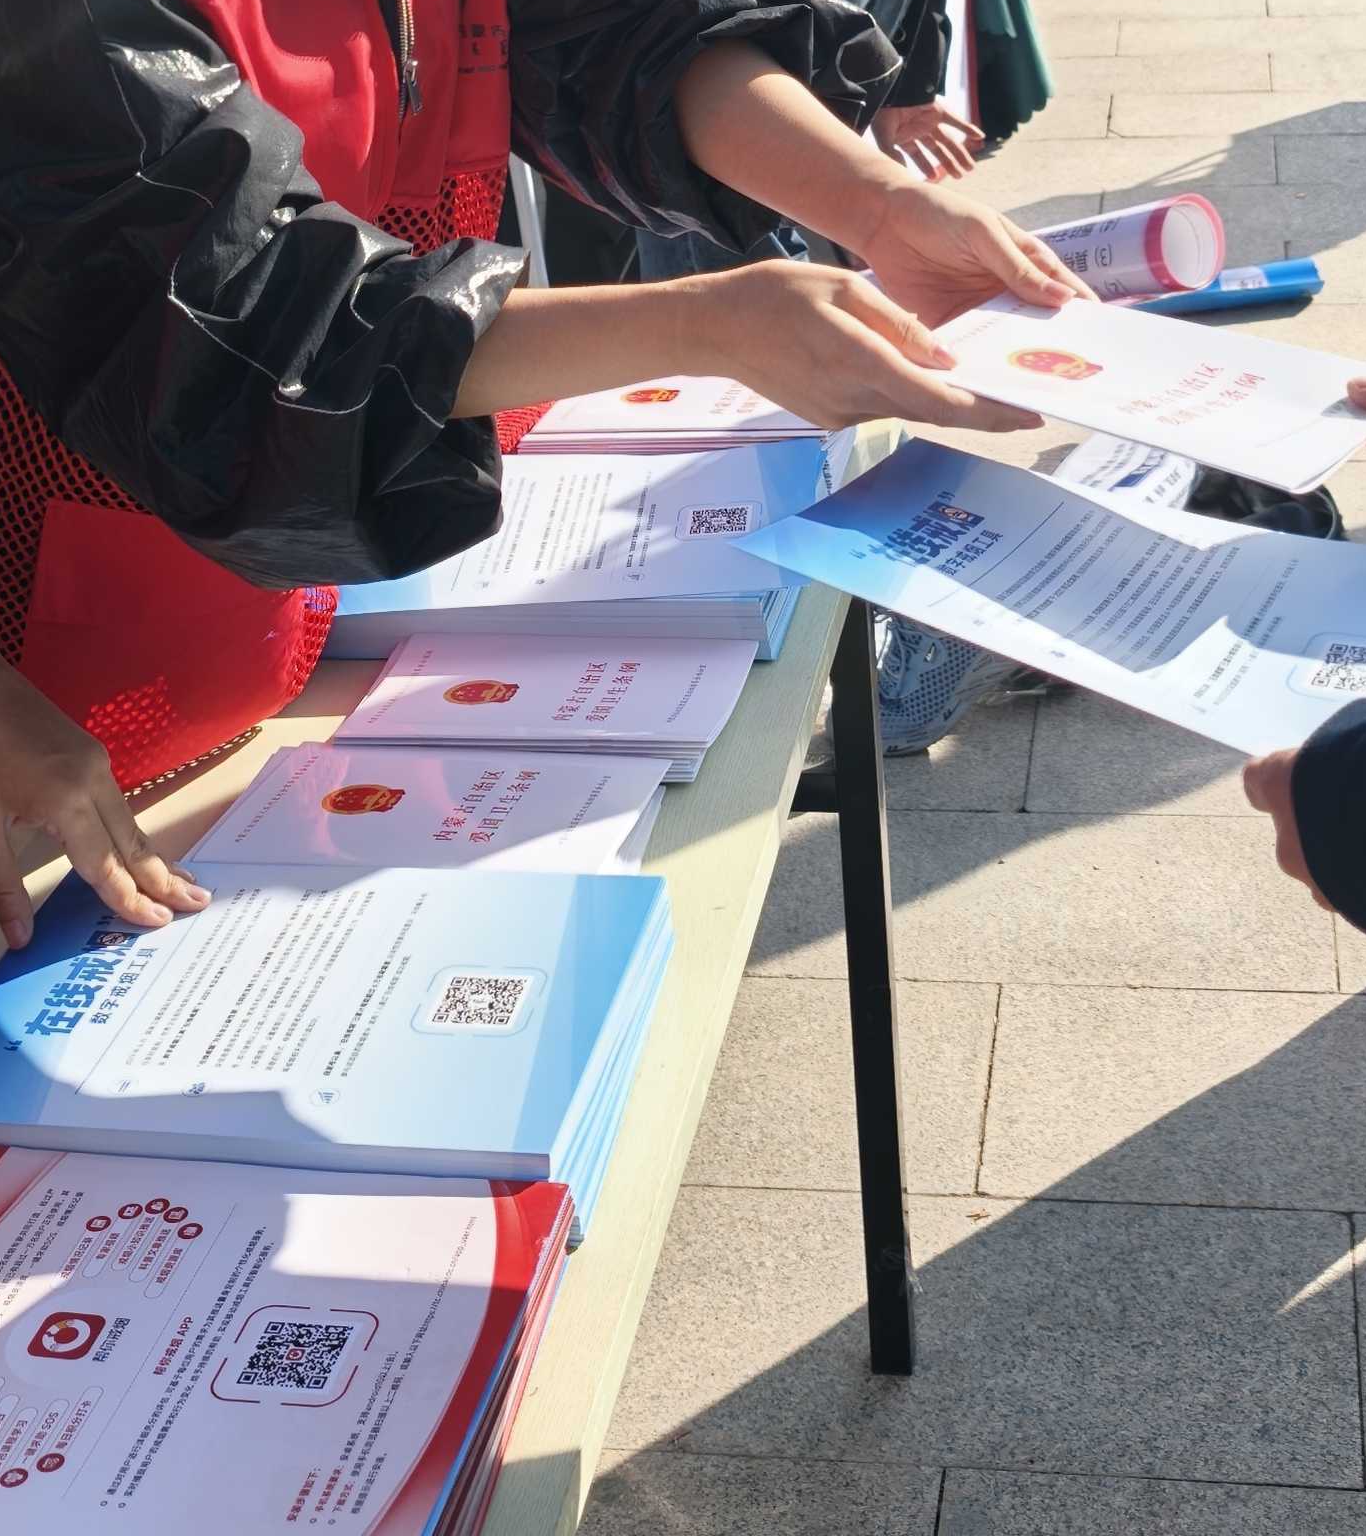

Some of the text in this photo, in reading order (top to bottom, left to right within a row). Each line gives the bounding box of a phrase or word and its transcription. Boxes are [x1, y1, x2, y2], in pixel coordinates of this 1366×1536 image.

[550, 661, 609, 720] 内蒙古自治区
[583, 661, 642, 722] 爱国卫生条例
[429, 769, 506, 840] 内蒙古自治区
[463, 770, 542, 843] 爱国卫生条例
[86, 947, 160, 1024] 数字戒烟工具
[58, 1236, 94, 1278] 戒烟情况记录
[95, 1232, 121, 1259] 专家视频
[117, 1215, 157, 1264] 戒烟小知识推送
[137, 1228, 172, 1269] 科普文章推送
[154, 1247, 185, 1283] 戒烟资源库
[91, 1317, 132, 1362] 帮你戒烟
[151, 1316, 196, 1375] 帮你戒烟 APP
[18, 1411, 60, 1464] 一键求助 SOS
[54, 1399, 94, 1449] 每日积分打卡
